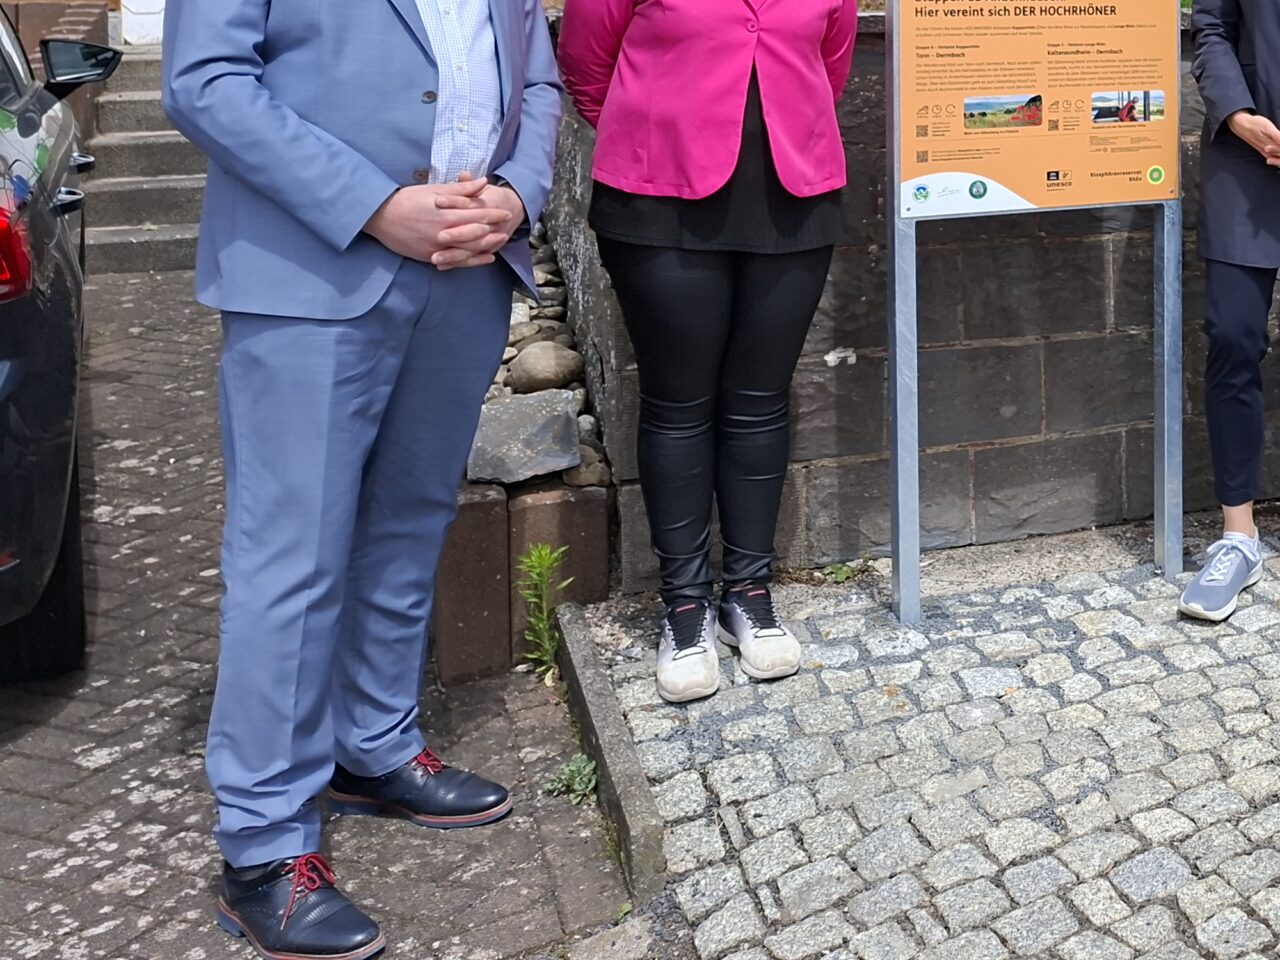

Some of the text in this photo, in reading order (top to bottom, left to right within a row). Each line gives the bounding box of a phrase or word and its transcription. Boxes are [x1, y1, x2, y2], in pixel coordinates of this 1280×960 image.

[915, 3, 1117, 17] Hier vereint sich DER HOCHRHÖNER
[1046, 180, 1073, 188] unesco
